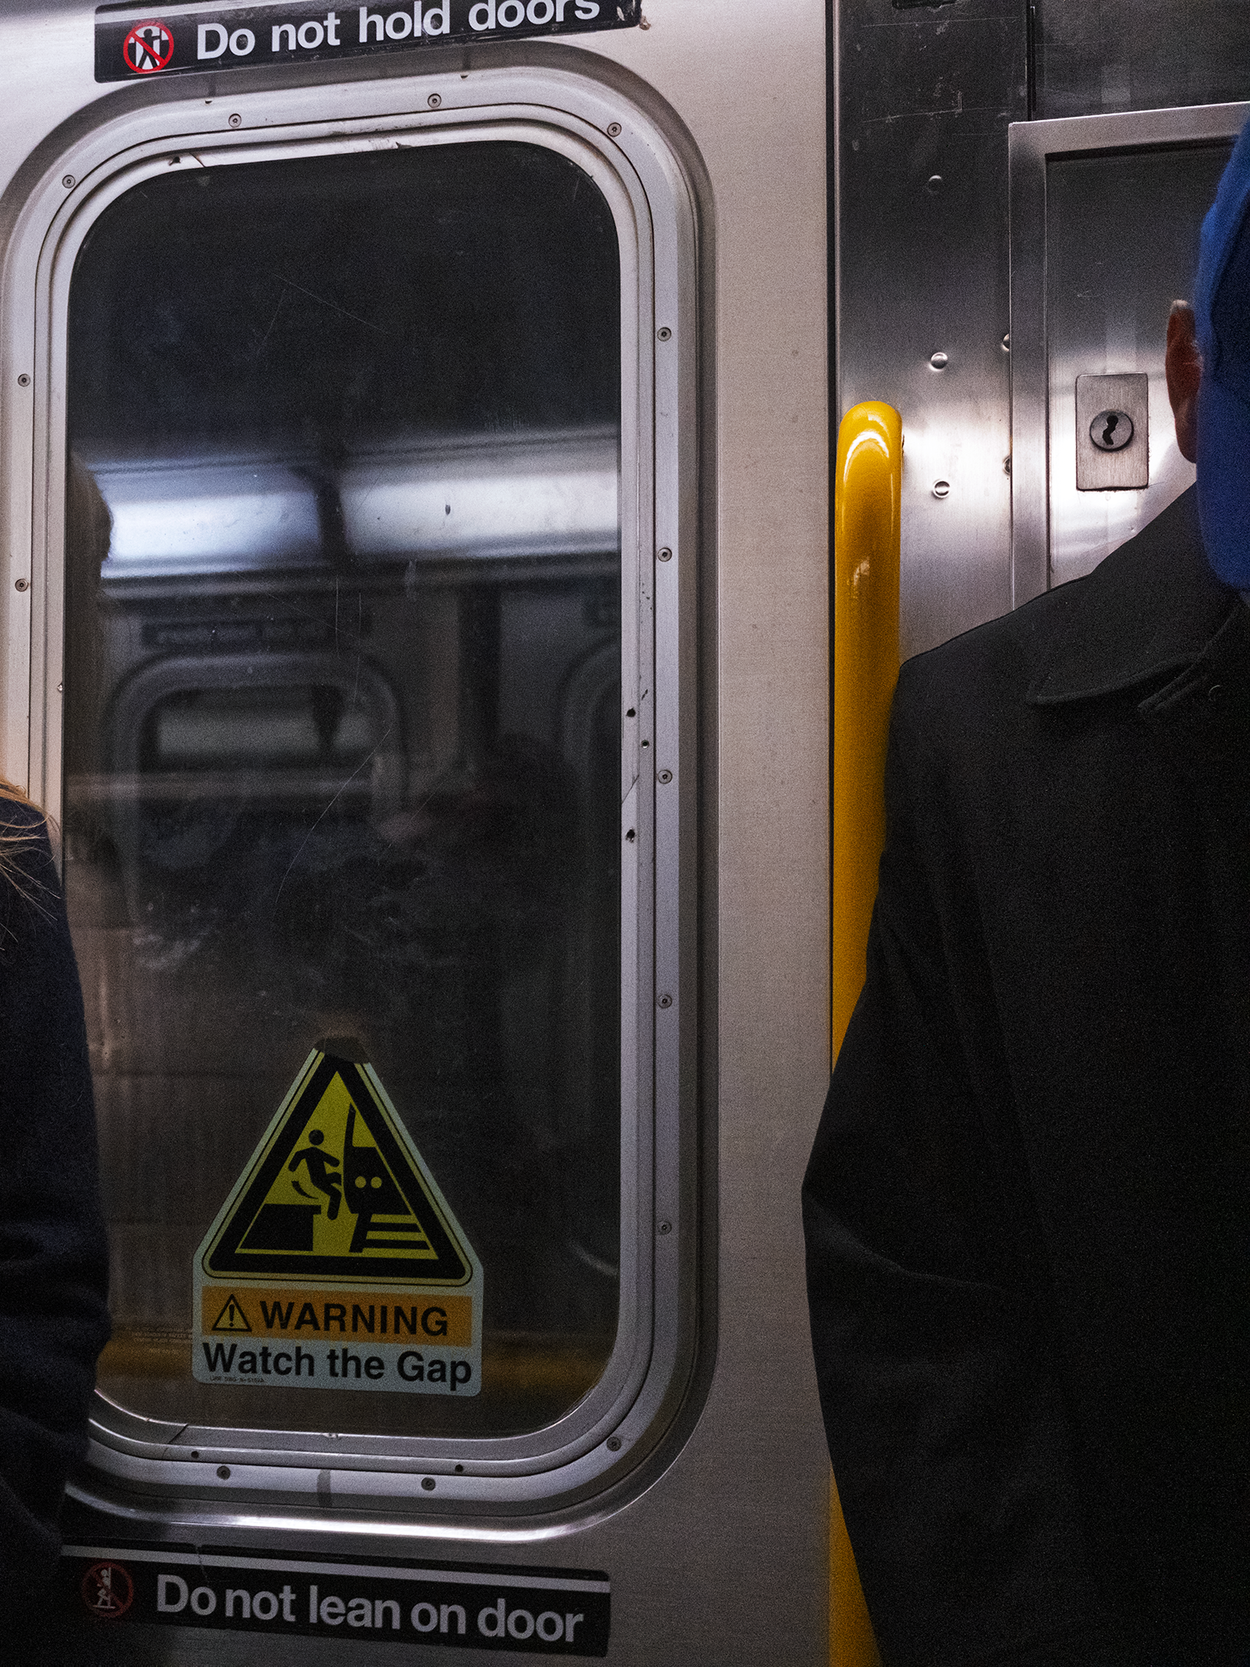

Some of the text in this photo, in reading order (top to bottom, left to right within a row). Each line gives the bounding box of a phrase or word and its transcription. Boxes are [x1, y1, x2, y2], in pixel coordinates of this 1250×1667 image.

[198, 0, 600, 60] Do not hold doors
[260, 1300, 448, 1337] WARNING
[203, 1342, 473, 1392] Watch the Gap
[157, 1575, 584, 1643] Do not lean on door
